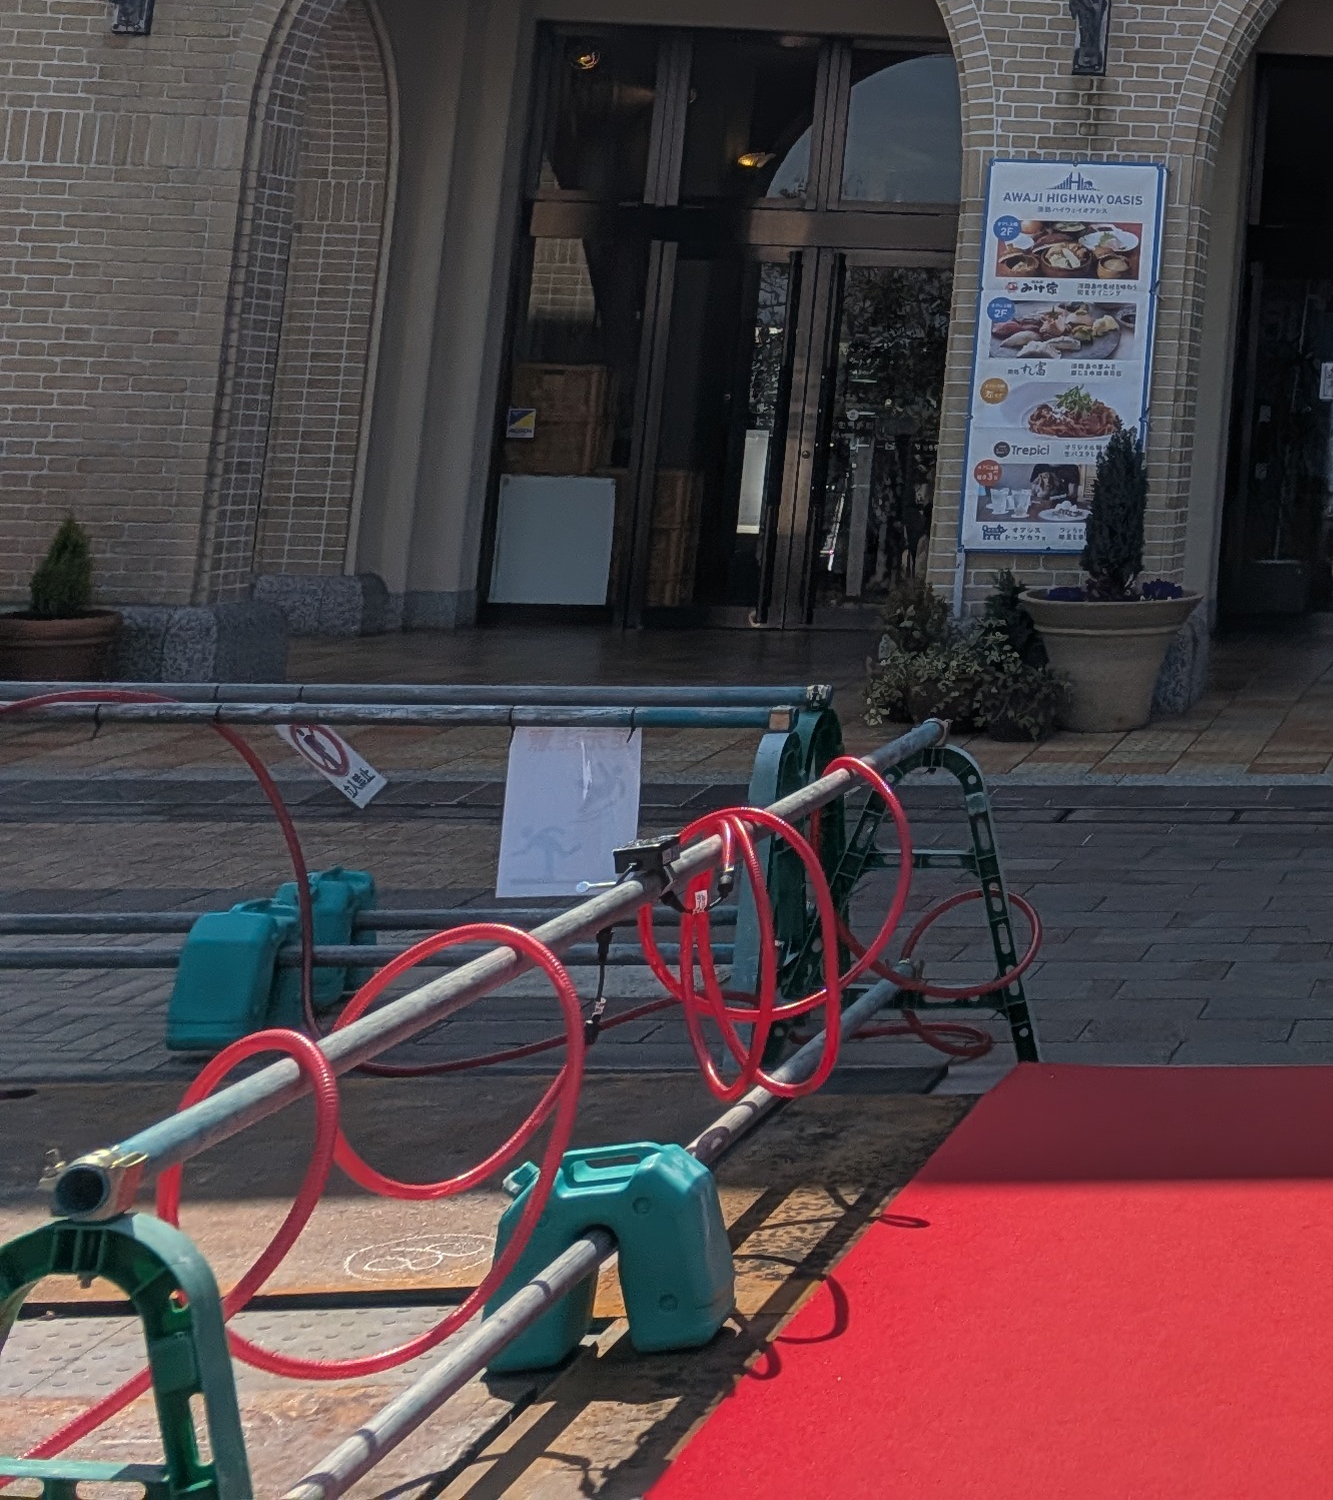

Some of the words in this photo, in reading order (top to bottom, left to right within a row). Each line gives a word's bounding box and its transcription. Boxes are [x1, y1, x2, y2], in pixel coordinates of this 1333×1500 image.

[1003, 192, 1043, 203] AWAJI
[1047, 193, 1104, 205] HIGHWAY
[1107, 195, 1143, 206] OASIS
[1000, 227, 1014, 236] 2F
[994, 309, 1008, 319] 2F
[1011, 444, 1050, 456] Trepici
